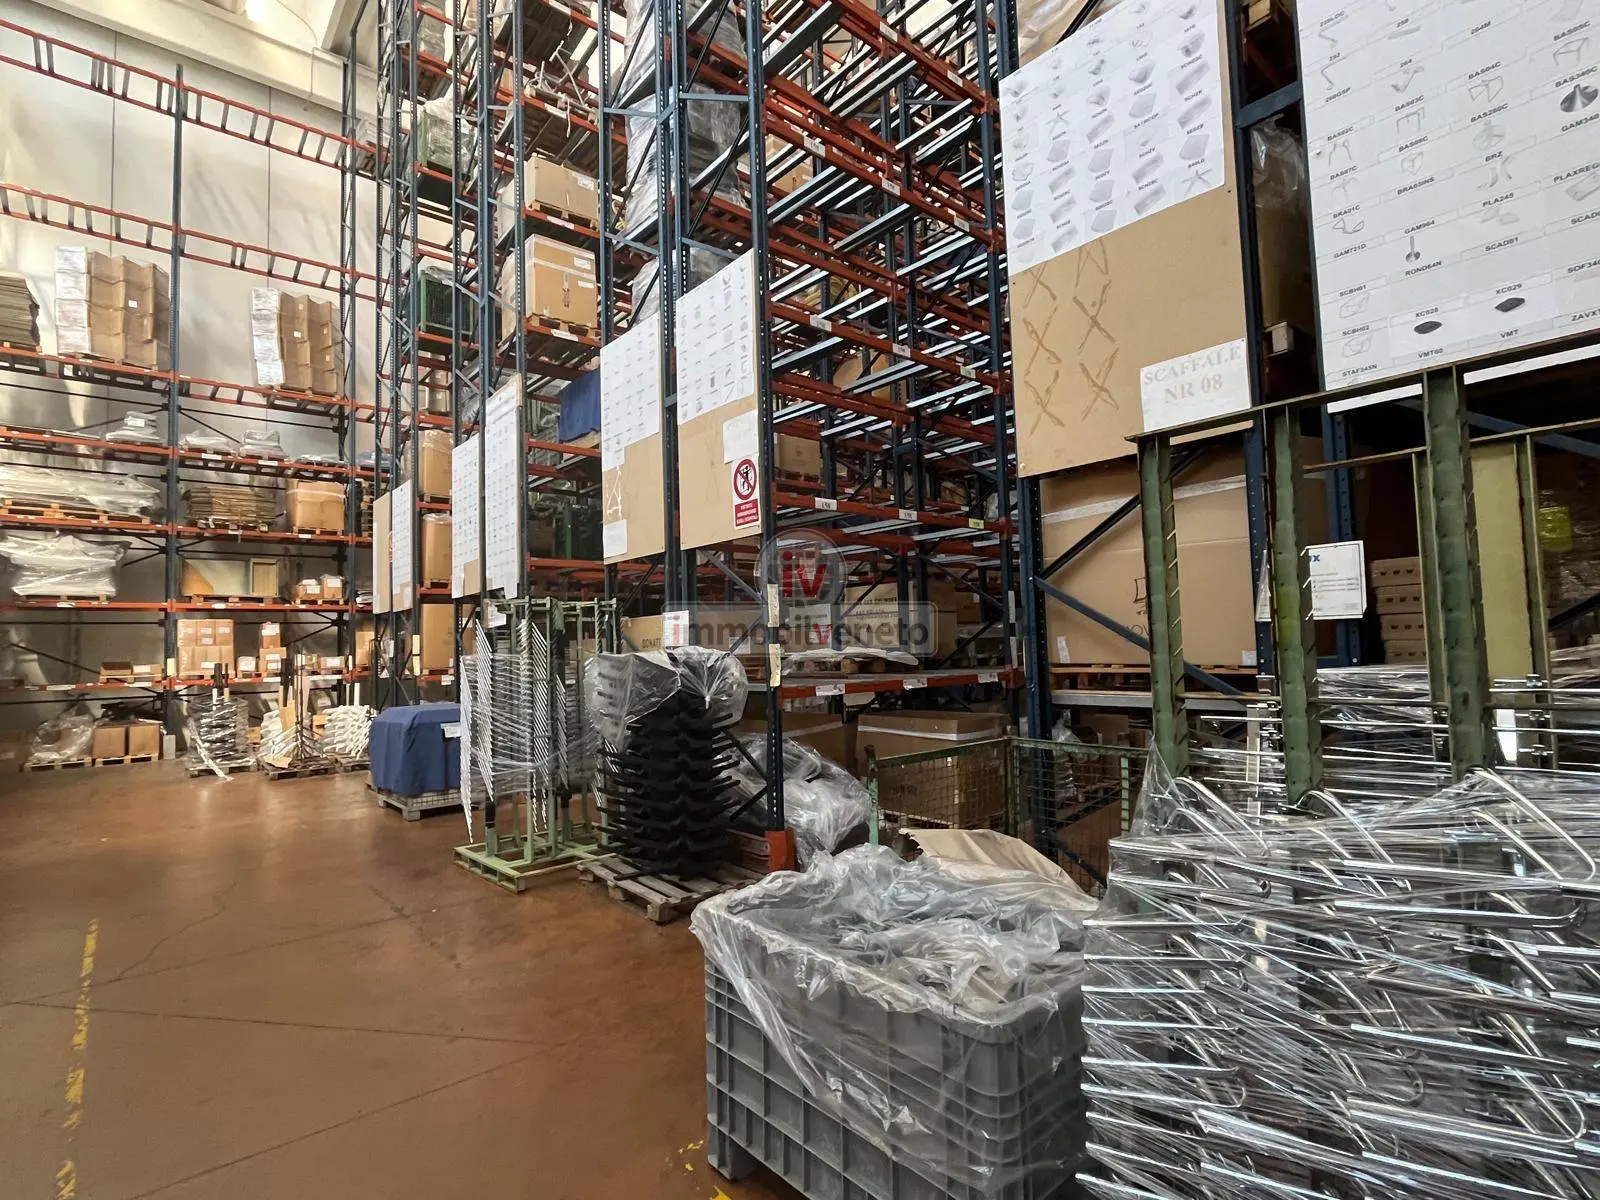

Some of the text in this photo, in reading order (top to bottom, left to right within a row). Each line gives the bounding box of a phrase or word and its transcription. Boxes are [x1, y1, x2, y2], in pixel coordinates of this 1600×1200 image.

[1500, 328, 1519, 339] VMT
[1144, 346, 1241, 386] SCAFFALE
[1163, 374, 1223, 404] NR 08
